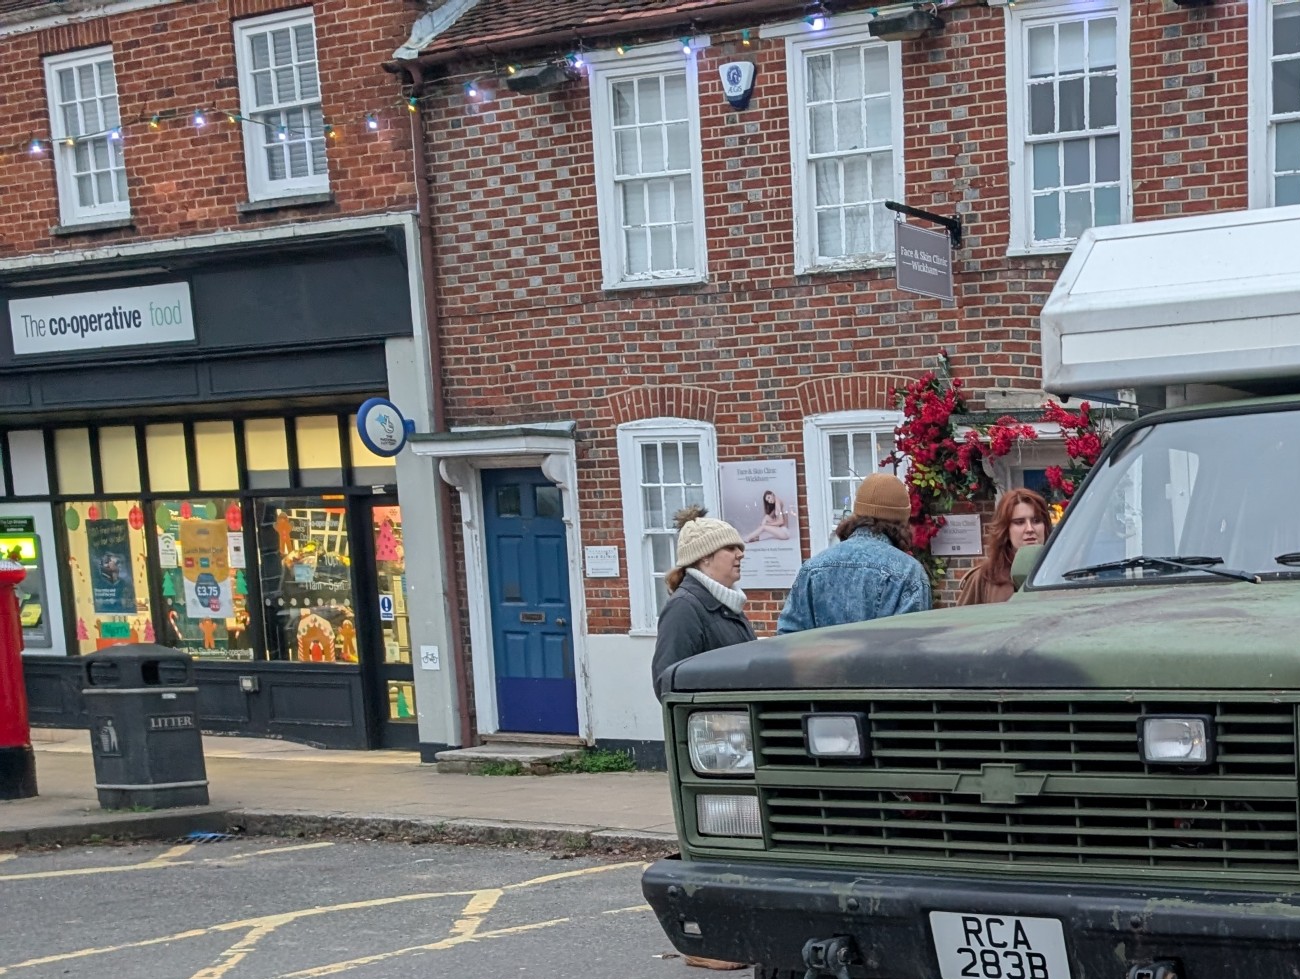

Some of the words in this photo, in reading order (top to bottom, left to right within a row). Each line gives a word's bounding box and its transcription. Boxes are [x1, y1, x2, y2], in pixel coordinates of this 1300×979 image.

[900, 245, 914, 258] Face
[914, 249, 919, 260] &
[919, 250, 932, 263] Skin
[932, 254, 948, 267] Clinic
[911, 260, 939, 276] Wickham
[21, 314, 47, 338] The
[149, 298, 183, 327] food
[752, 467, 764, 475] Skin
[763, 466, 777, 474] Clinic
[196, 586, 219, 597] £3.75
[305, 580, 322, 591] 11am
[150, 716, 193, 728] LITTER
[961, 915, 1033, 951] RCA
